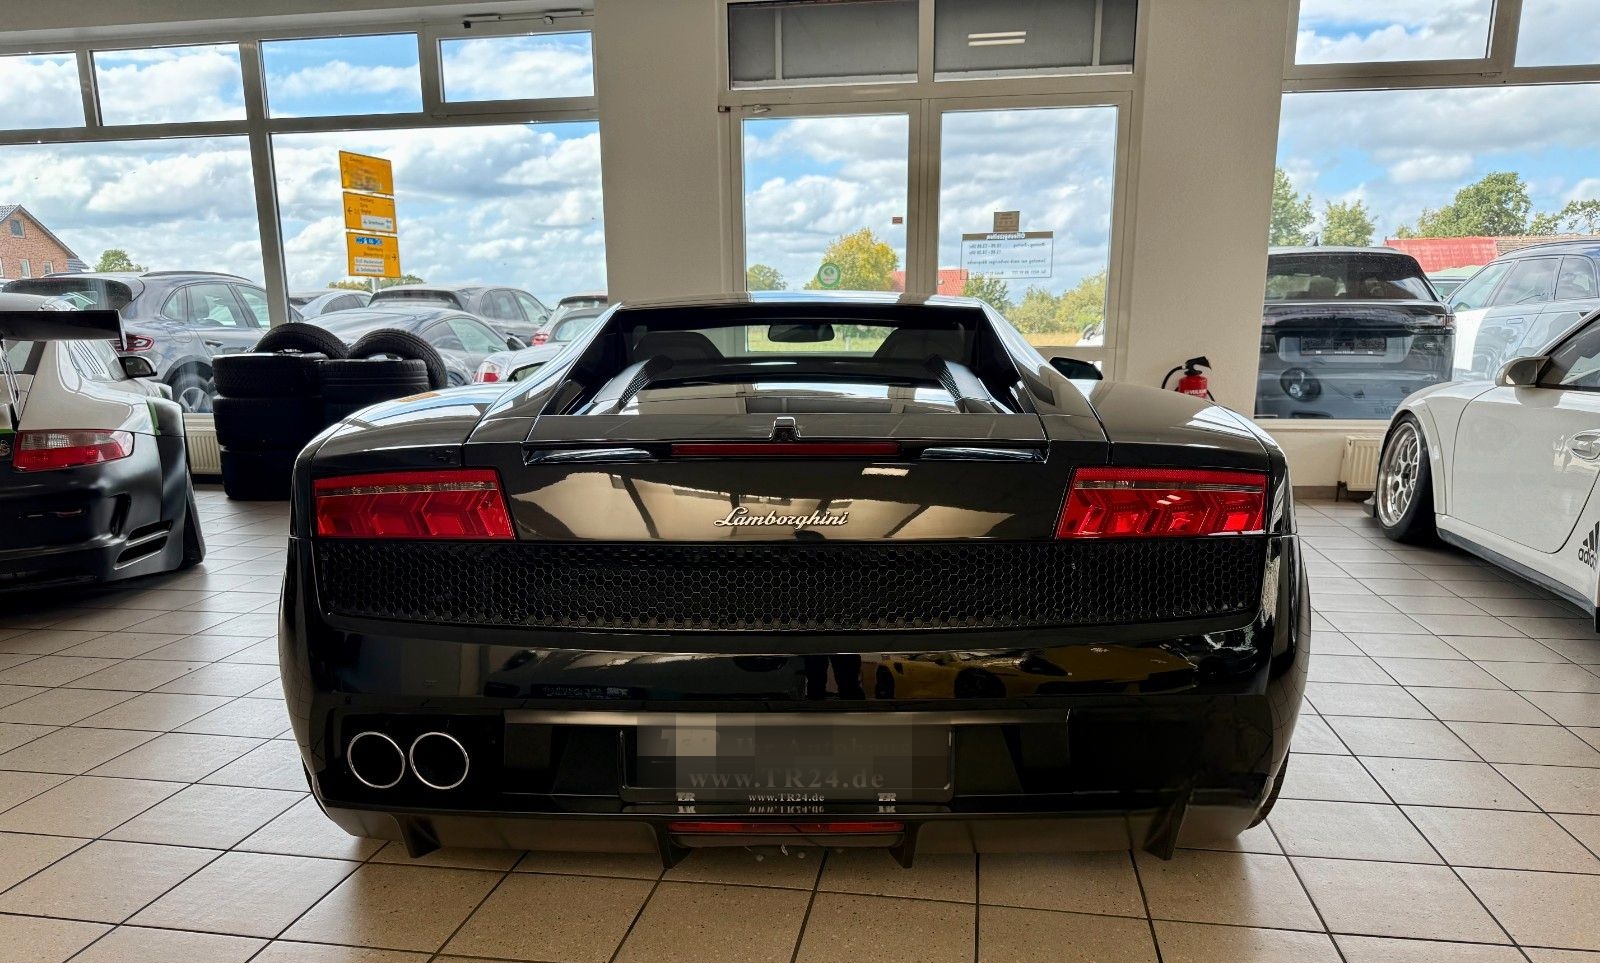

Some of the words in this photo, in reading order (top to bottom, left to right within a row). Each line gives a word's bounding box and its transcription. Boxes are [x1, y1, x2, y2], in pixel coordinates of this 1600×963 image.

[713, 506, 849, 530] Lamborghini
[688, 768, 884, 788] www.TR24.de
[748, 792, 825, 802] www.TR24.de
